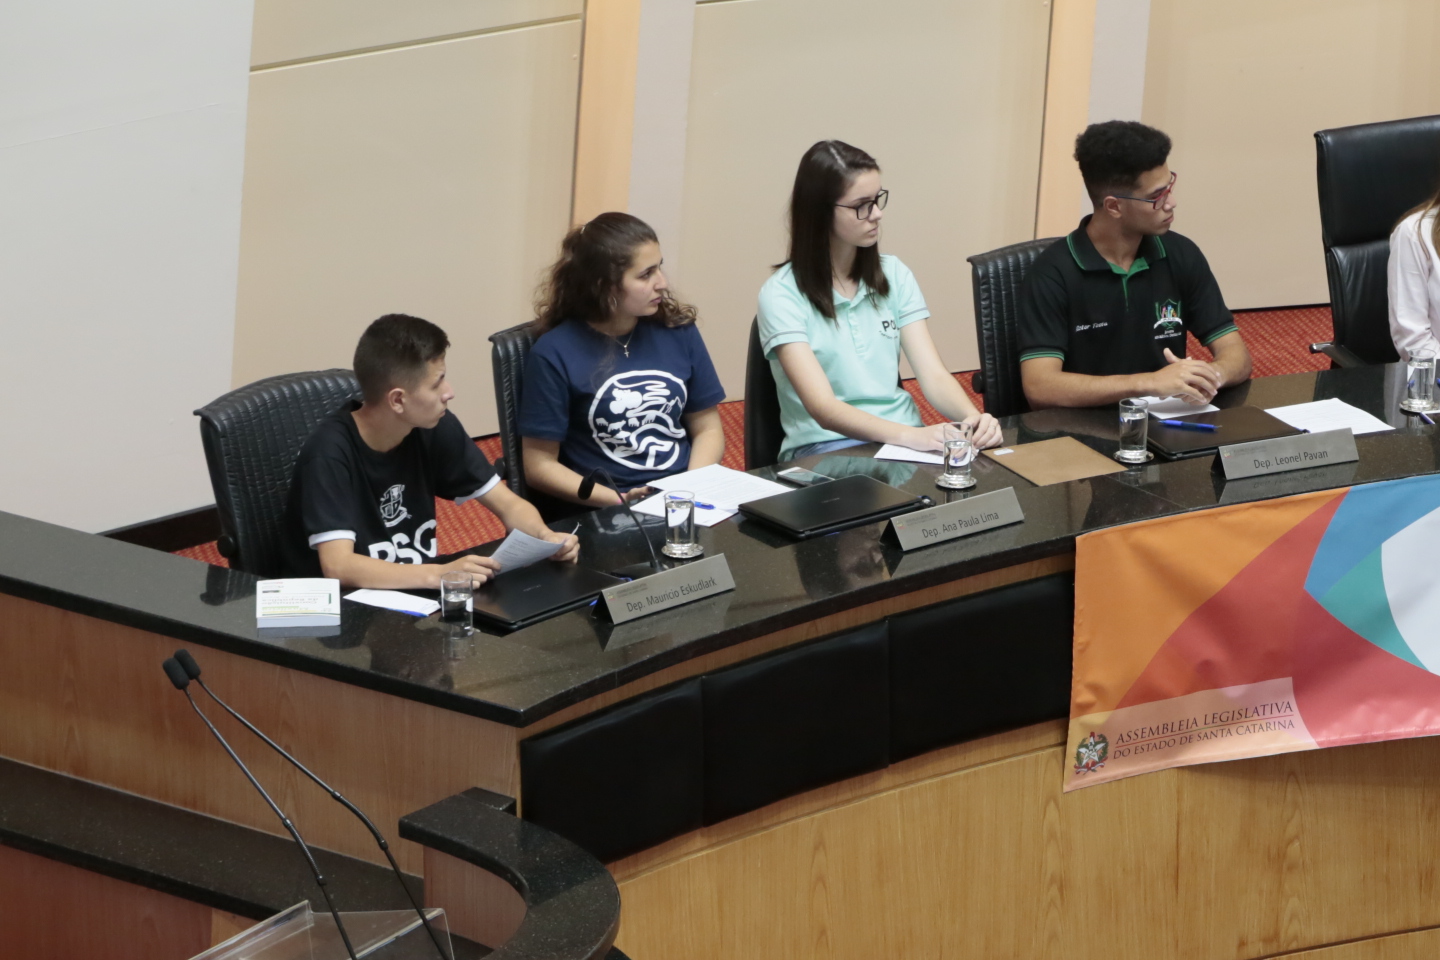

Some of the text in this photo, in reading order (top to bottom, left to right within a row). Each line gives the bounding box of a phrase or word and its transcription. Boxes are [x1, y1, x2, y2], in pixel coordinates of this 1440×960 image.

[1253, 449, 1329, 470] Dep. Leonel Pavan
[922, 511, 1000, 539] Dep. Ana Paula Lima
[626, 601, 646, 613] Dep.
[680, 576, 718, 597] Eskudlark
[1113, 719, 1295, 760] DO ESTADO DE SANTA CATARINA
[1115, 700, 1293, 746] ASSEMBLEIA LEGISLATIVA
